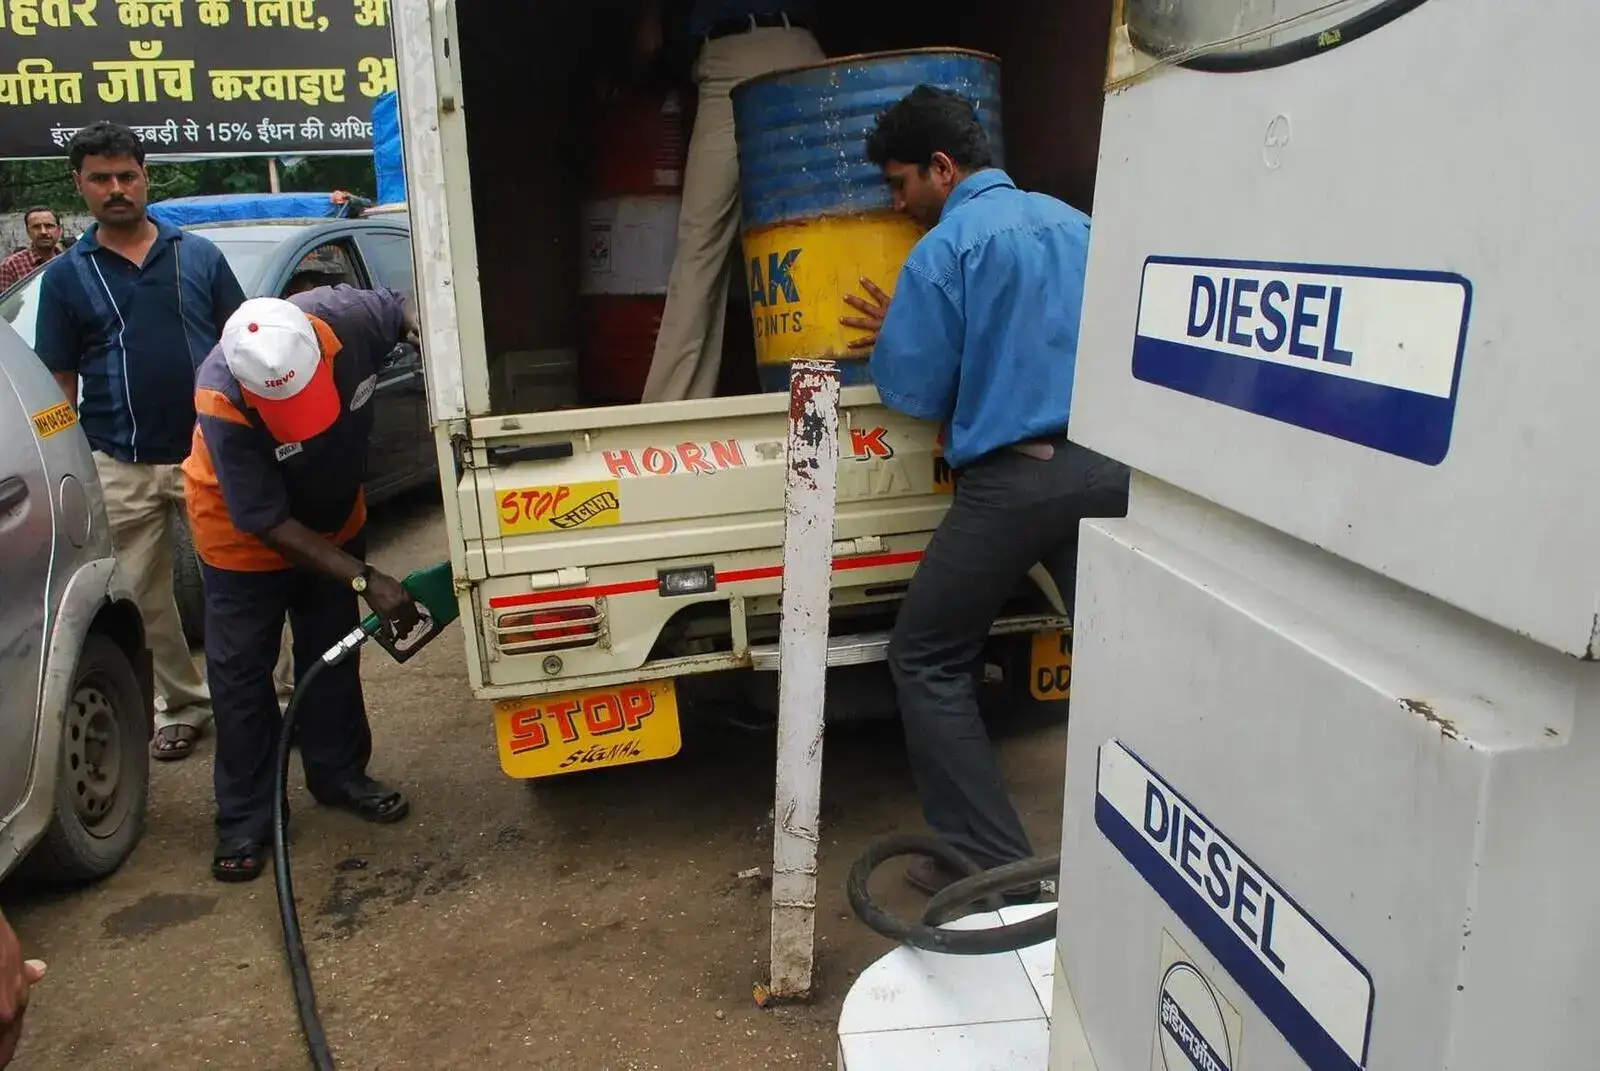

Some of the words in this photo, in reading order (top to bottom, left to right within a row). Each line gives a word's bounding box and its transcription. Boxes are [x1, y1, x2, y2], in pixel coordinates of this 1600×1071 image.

[182, 118, 201, 143] से
[206, 121, 253, 143] 15%
[298, 116, 324, 142] की
[1187, 274, 1353, 366] DIESEL
[265, 369, 295, 389] SERVO
[602, 436, 747, 478] HORN
[847, 425, 894, 462] K
[500, 485, 570, 525] STOP
[509, 687, 656, 755] STOP
[1143, 779, 1286, 975] DIESEL
